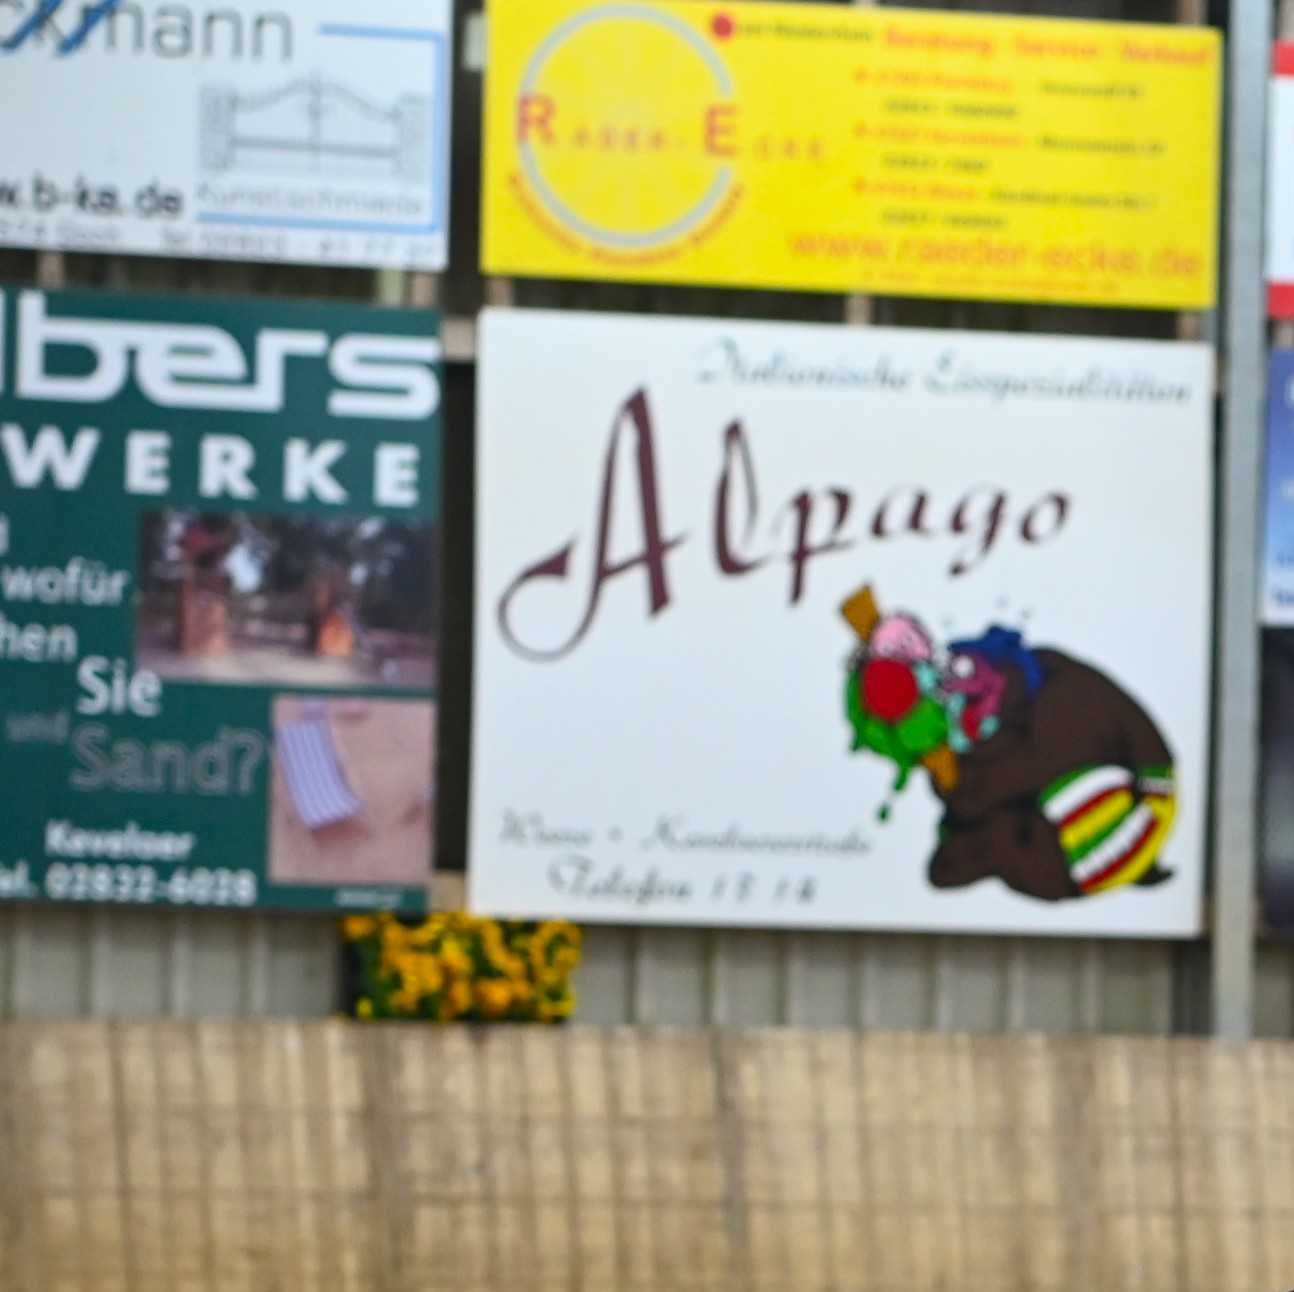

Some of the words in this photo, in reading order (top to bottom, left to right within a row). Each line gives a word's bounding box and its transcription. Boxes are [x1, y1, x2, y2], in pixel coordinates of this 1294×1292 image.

[0, 288, 442, 421] bers
[497, 385, 1075, 664] Alpago
[2, 555, 131, 606] wofür
[76, 653, 163, 718] Sie
[68, 718, 268, 797] Sand?
